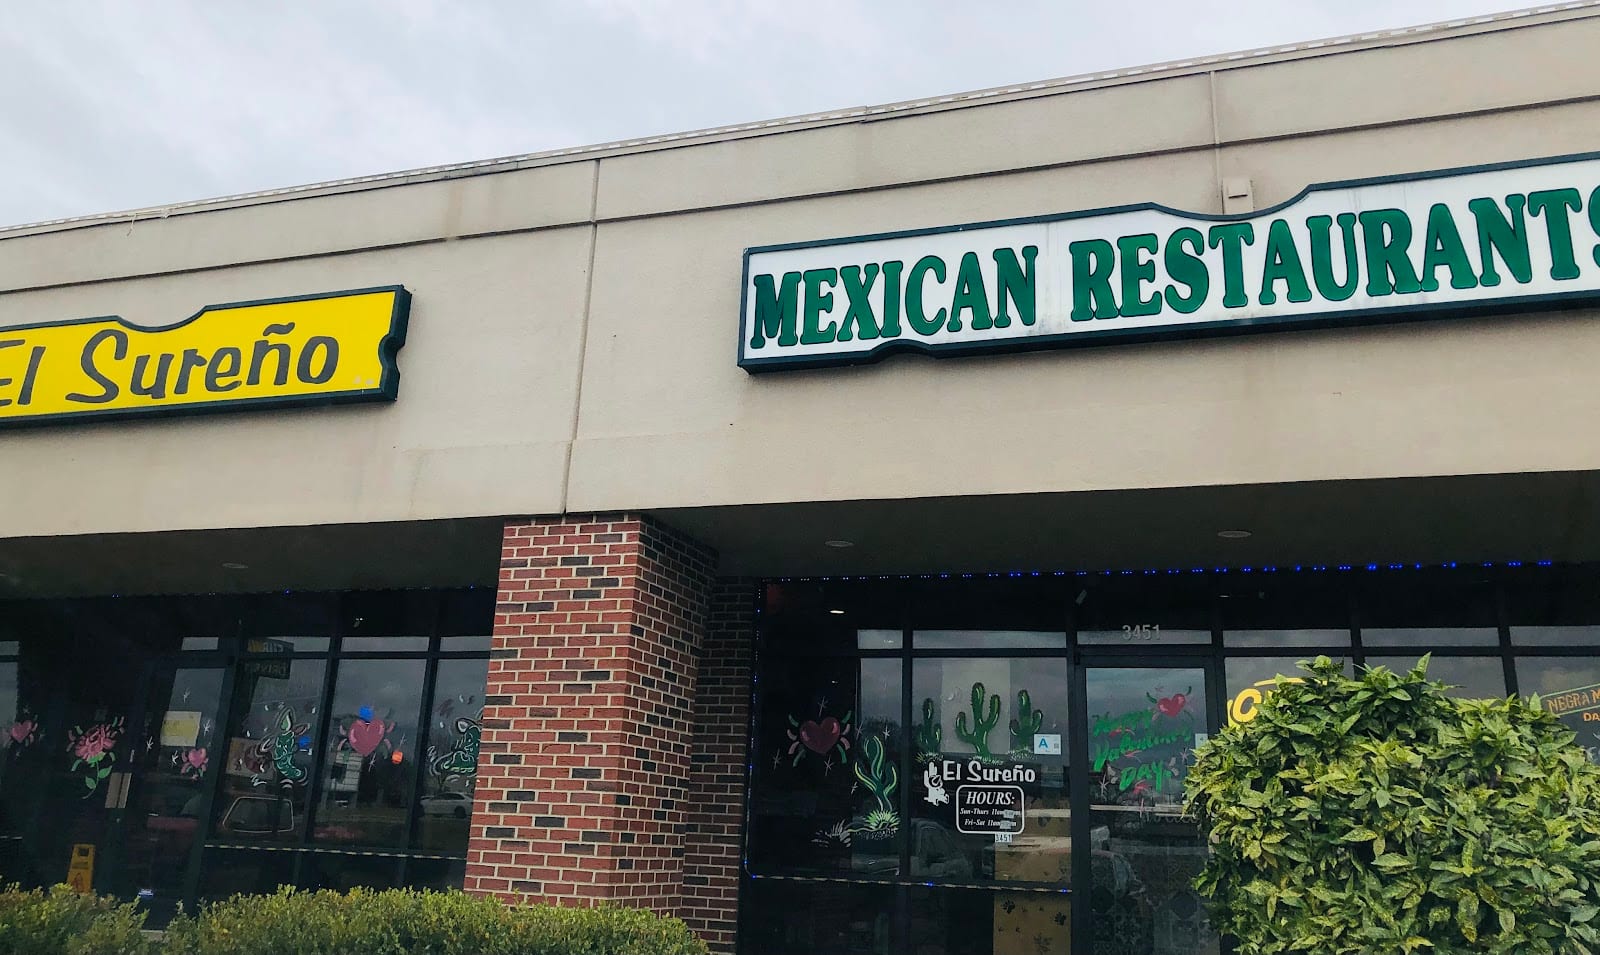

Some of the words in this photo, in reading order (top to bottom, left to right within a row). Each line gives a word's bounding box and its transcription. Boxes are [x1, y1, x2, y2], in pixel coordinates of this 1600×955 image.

[750, 244, 1038, 349] MEXICAN
[65, 321, 340, 404] Sureño
[1122, 624, 1160, 640] 3451
[1546, 692, 1590, 713] NEGRA
[1038, 737, 1049, 748] A
[943, 760, 961, 781] El
[966, 761, 1036, 782] Sureño
[966, 791, 1015, 805] HOURS:
